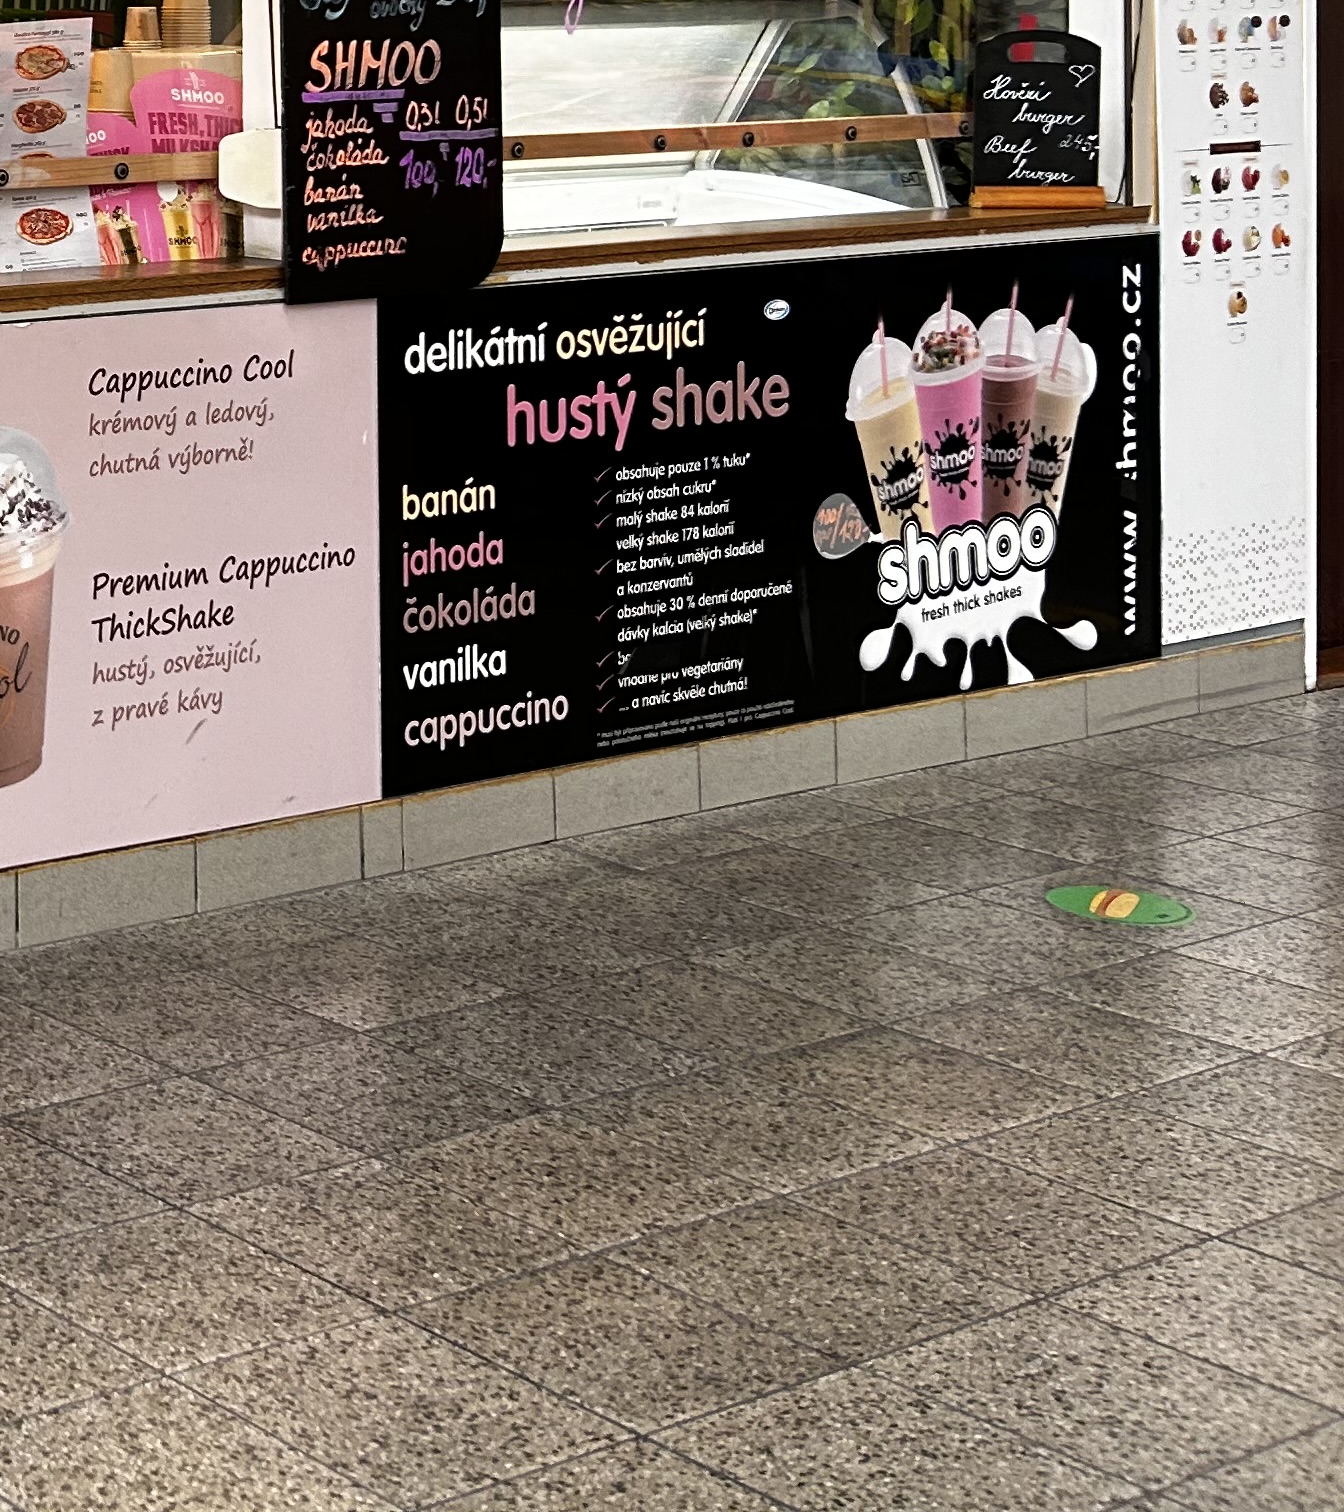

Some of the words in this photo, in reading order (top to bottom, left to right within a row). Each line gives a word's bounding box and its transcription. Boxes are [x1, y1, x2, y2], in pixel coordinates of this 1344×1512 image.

[304, 38, 441, 92] SHMOO
[171, 88, 225, 104] SHMOO
[984, 135, 1037, 163] Beef
[1007, 159, 1075, 186] burger
[404, 322, 547, 376] delikátní
[556, 308, 707, 362] osvěžující
[88, 358, 233, 403] Cappuccino
[243, 349, 295, 382] Cool
[88, 407, 177, 436] krémový
[185, 410, 197, 427] a
[206, 397, 275, 426] ledový,
[507, 376, 637, 451] hustý
[652, 360, 791, 431] shake
[88, 447, 160, 476] chutná
[168, 437, 254, 474] výborně!
[615, 462, 665, 481] obsahuje
[669, 460, 702, 475] pouze
[402, 479, 496, 522] banán
[646, 508, 678, 522] shake
[681, 505, 695, 518] 84
[682, 527, 700, 541] 178
[92, 562, 208, 600] Premium
[219, 543, 355, 589] Cappuccino
[402, 532, 504, 587] jahoda
[878, 504, 1057, 608] shmoo
[92, 600, 235, 643] ThickShake
[403, 584, 536, 636] čokoláda
[921, 599, 953, 624] fresh
[954, 594, 983, 614] thick
[984, 583, 1023, 610] shakes
[92, 655, 155, 685] hustý,
[163, 639, 261, 675] osvěžující,
[403, 646, 508, 690] vanilka
[92, 709, 104, 727] z
[111, 694, 169, 731] pravé
[177, 688, 223, 714] kávy
[404, 690, 570, 750] cappuccino
